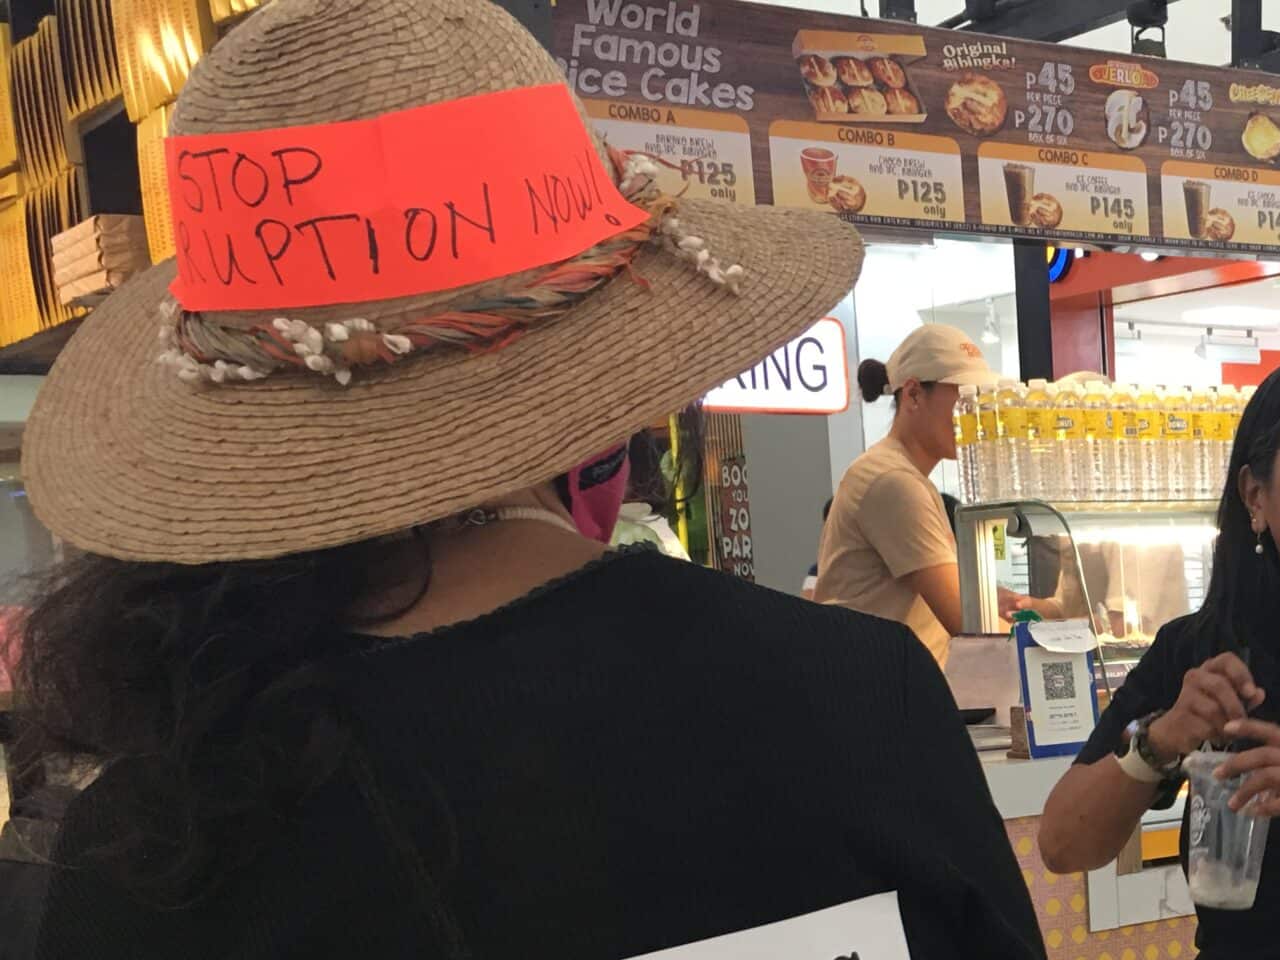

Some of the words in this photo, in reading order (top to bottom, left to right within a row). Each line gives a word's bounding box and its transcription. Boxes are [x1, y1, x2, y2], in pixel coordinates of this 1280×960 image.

[587, 0, 700, 37] World
[572, 24, 722, 73] Famous
[943, 42, 1007, 58] Original
[943, 54, 1016, 70] Bibingka!
[556, 56, 627, 97] ice
[641, 67, 754, 111] Cakes
[1026, 62, 1075, 95] P45
[1168, 79, 1213, 111] P45
[609, 104, 661, 122] COMBO
[666, 110, 676, 124] A
[1015, 104, 1074, 135] P270
[837, 128, 884, 146] COMBO
[887, 133, 895, 146] B
[1158, 121, 1213, 151] P270
[1038, 149, 1078, 165] COMBO
[1081, 153, 1089, 166] C
[177, 147, 322, 213] STOP
[1214, 166, 1249, 181] COMBO
[1251, 170, 1258, 182] D
[526, 149, 622, 235] NOW!
[711, 186, 736, 200] only
[898, 179, 946, 205] P125
[924, 204, 946, 218] only
[1091, 196, 1135, 219] P145
[1113, 220, 1133, 233] only
